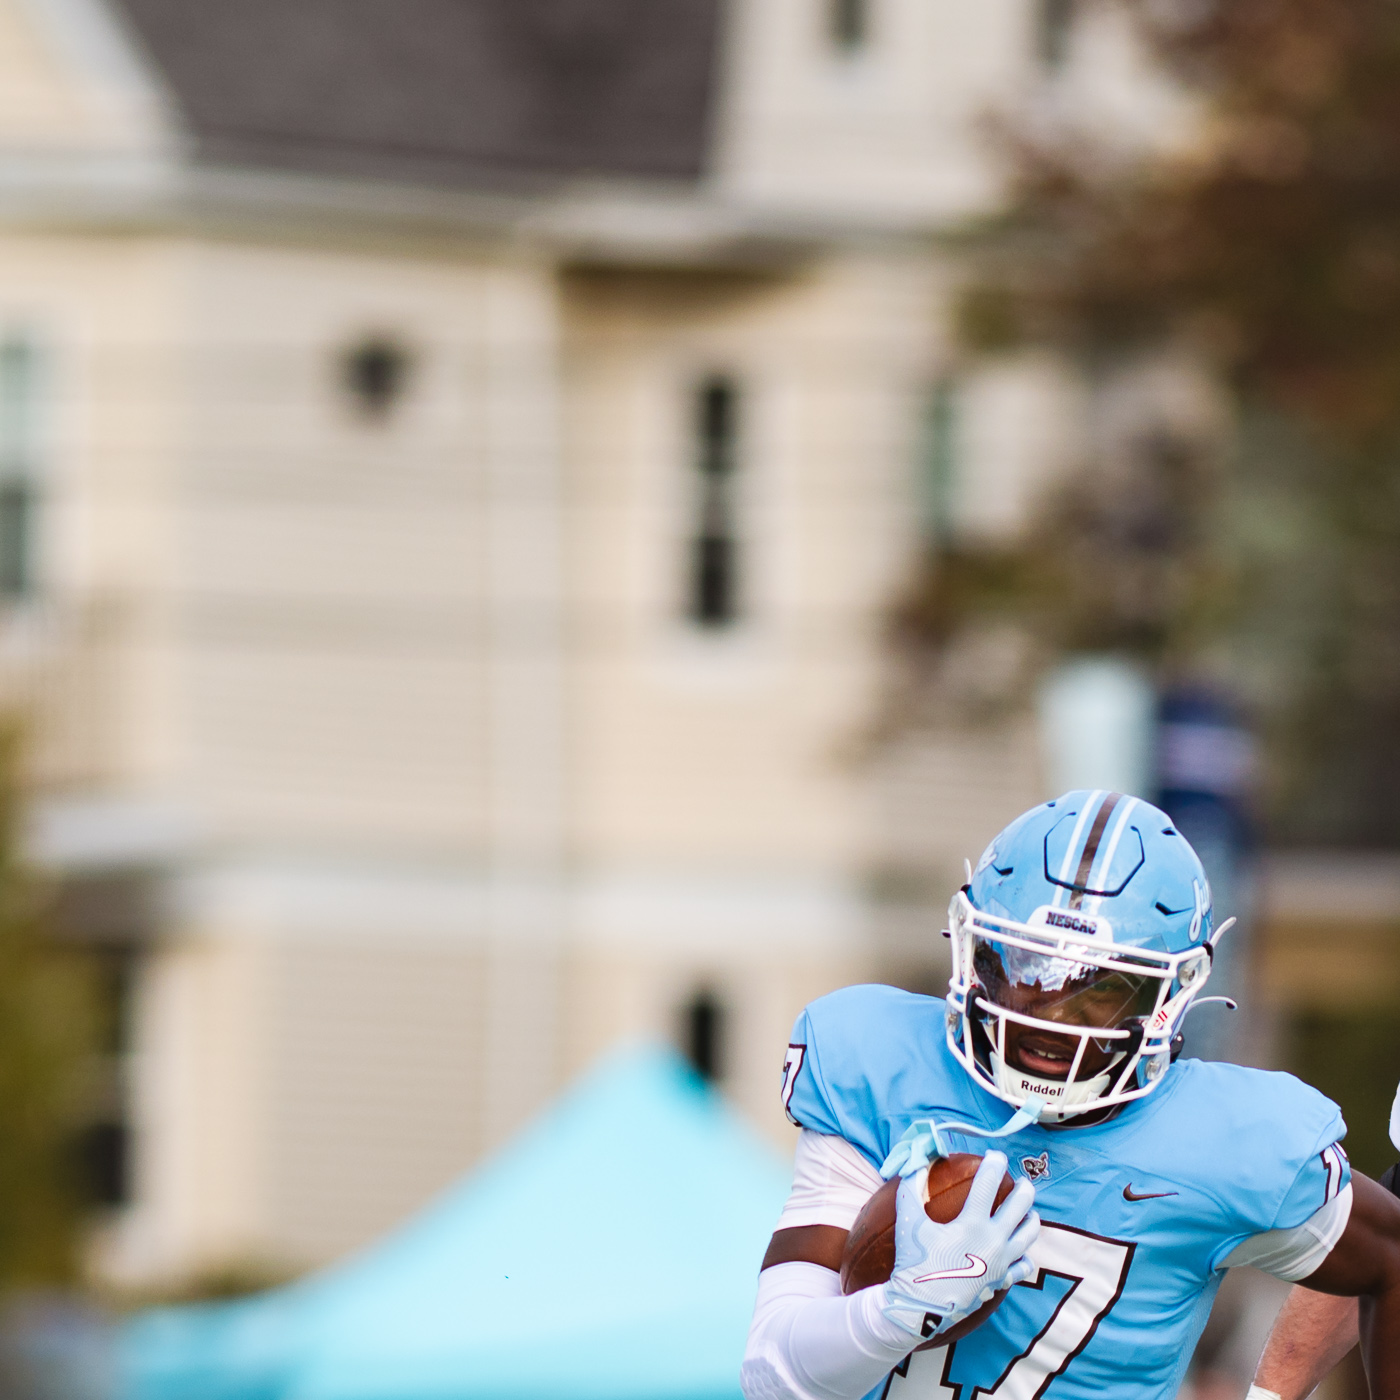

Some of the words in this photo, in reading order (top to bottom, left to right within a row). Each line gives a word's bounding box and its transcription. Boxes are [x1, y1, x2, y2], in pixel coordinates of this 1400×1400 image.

[1045, 911, 1097, 935] NESCAC
[1020, 1079, 1065, 1097] Riddell
[1319, 1141, 1349, 1206] 1
